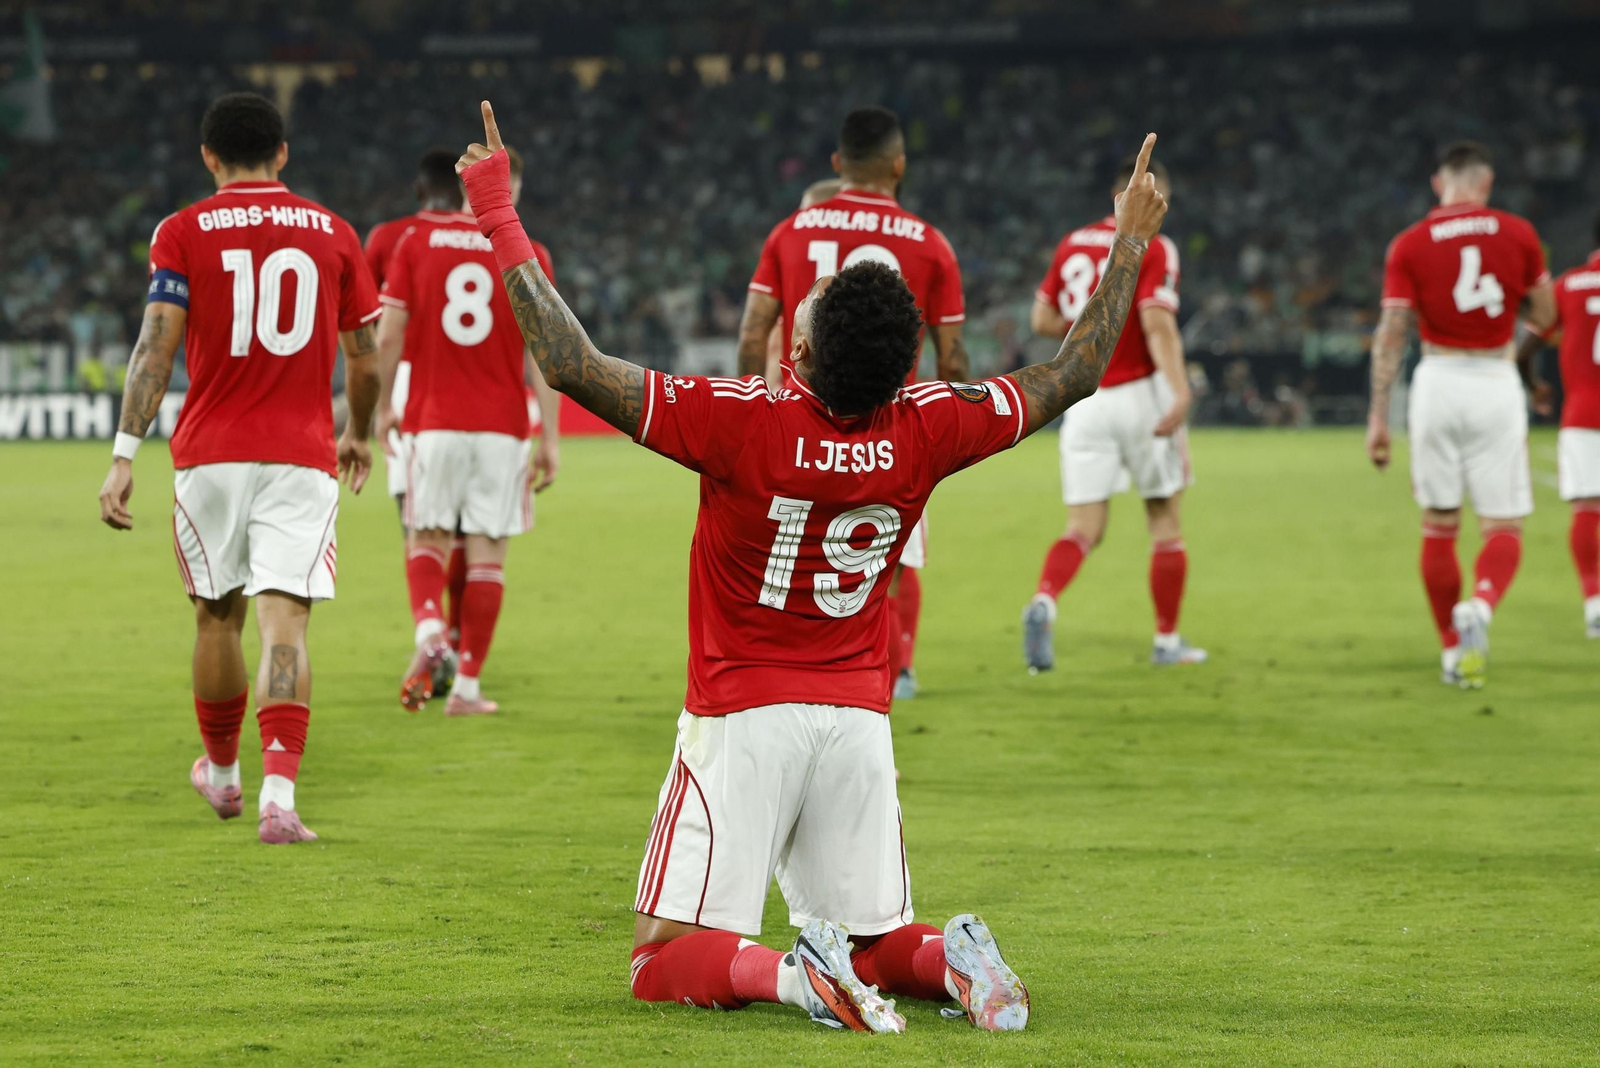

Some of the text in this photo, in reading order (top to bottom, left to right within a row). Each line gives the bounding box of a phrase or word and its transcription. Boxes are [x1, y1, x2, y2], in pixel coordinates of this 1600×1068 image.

[198, 205, 334, 235] GIBBS-WHITE
[793, 208, 926, 242] DOUGLAS LUIZ
[221, 247, 319, 357] 10
[441, 261, 494, 347] 8
[1453, 245, 1505, 318] 4
[795, 436, 894, 474] I. JESUS
[758, 495, 902, 618] 19
